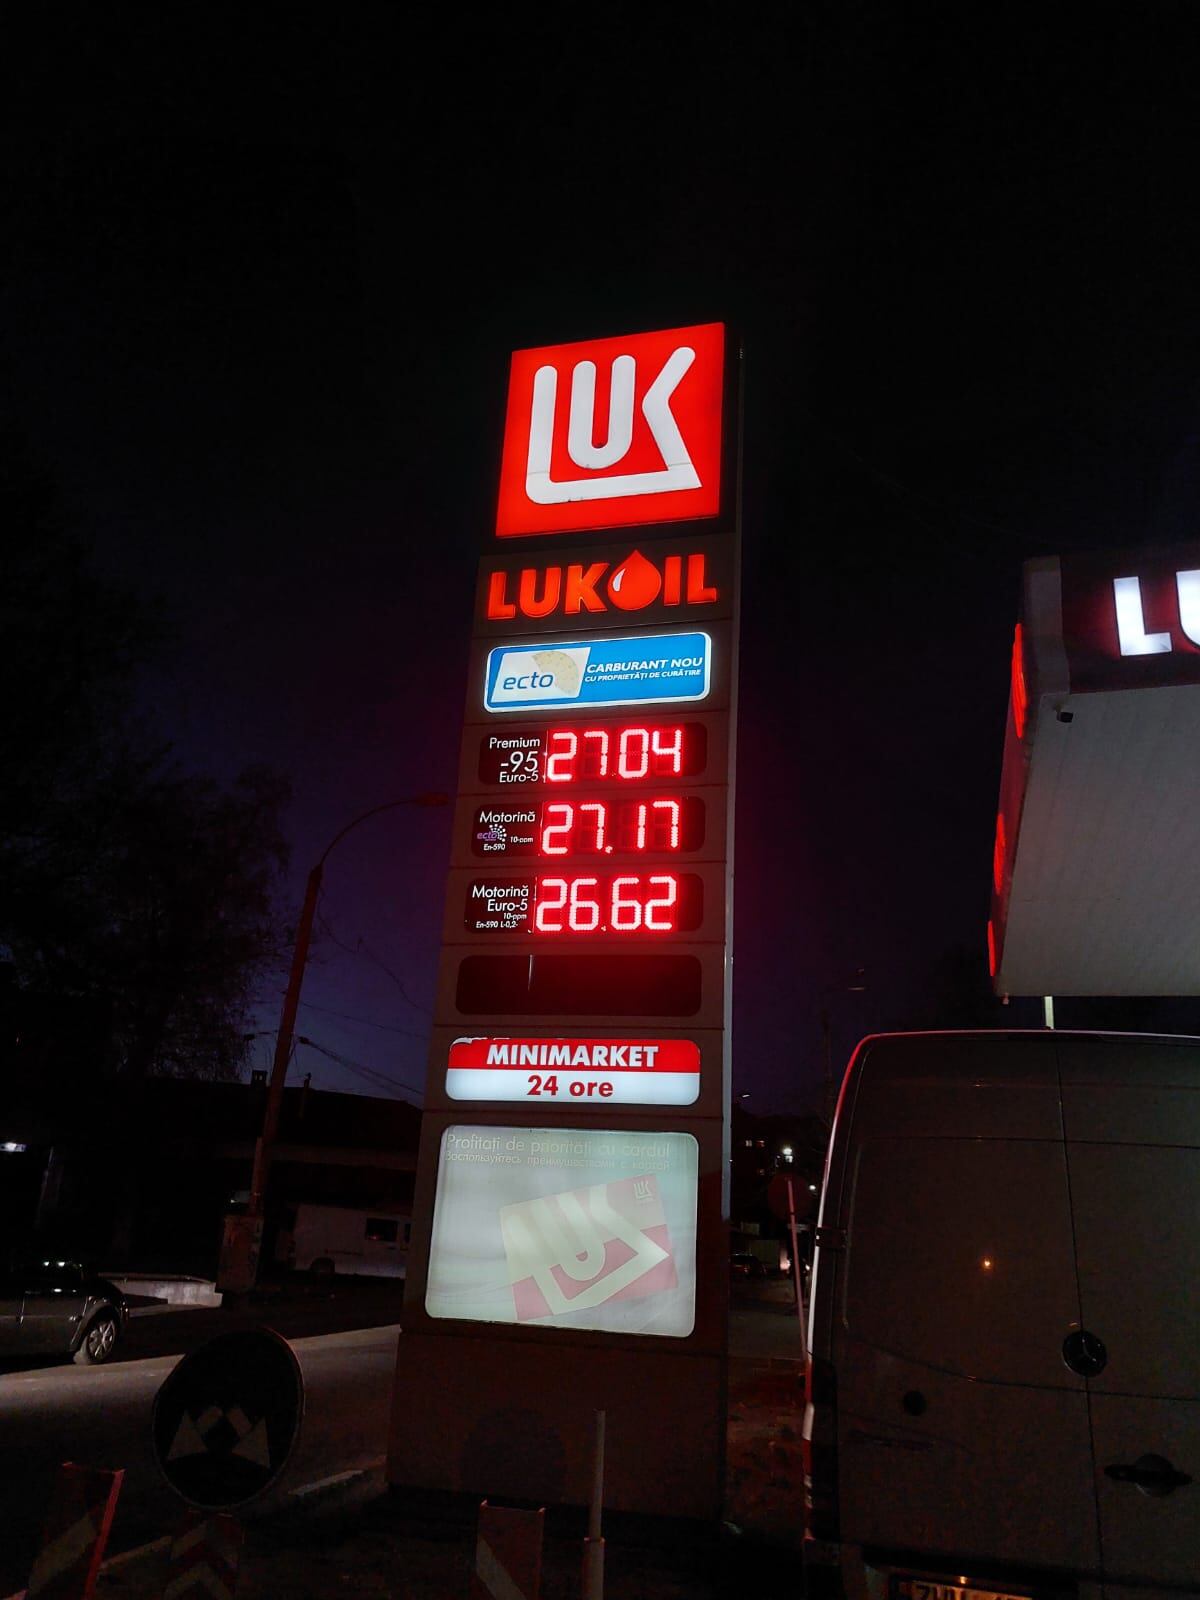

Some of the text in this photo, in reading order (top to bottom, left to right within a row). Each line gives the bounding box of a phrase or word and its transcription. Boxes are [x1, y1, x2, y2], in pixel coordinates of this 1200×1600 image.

[526, 347, 702, 505] LUK
[487, 549, 717, 620] LUKOIL
[586, 657, 703, 674] CARBURANT NOU
[503, 671, 554, 690] ecto
[489, 737, 541, 749] Premium
[500, 751, 538, 772] -95
[499, 770, 539, 783] Euro-5
[480, 810, 536, 823] Motorină
[542, 800, 679, 854] 27.17
[483, 843, 506, 851] En-590
[472, 885, 529, 898] Motorină
[487, 898, 528, 912] Euro-5
[536, 876, 677, 931] 26.62
[476, 920, 499, 928] En-590
[503, 912, 527, 920] 10-ppm
[486, 1044, 659, 1068] MINIMARKET
[527, 1075, 613, 1097] 24 ore
[506, 1135, 524, 1151] de
